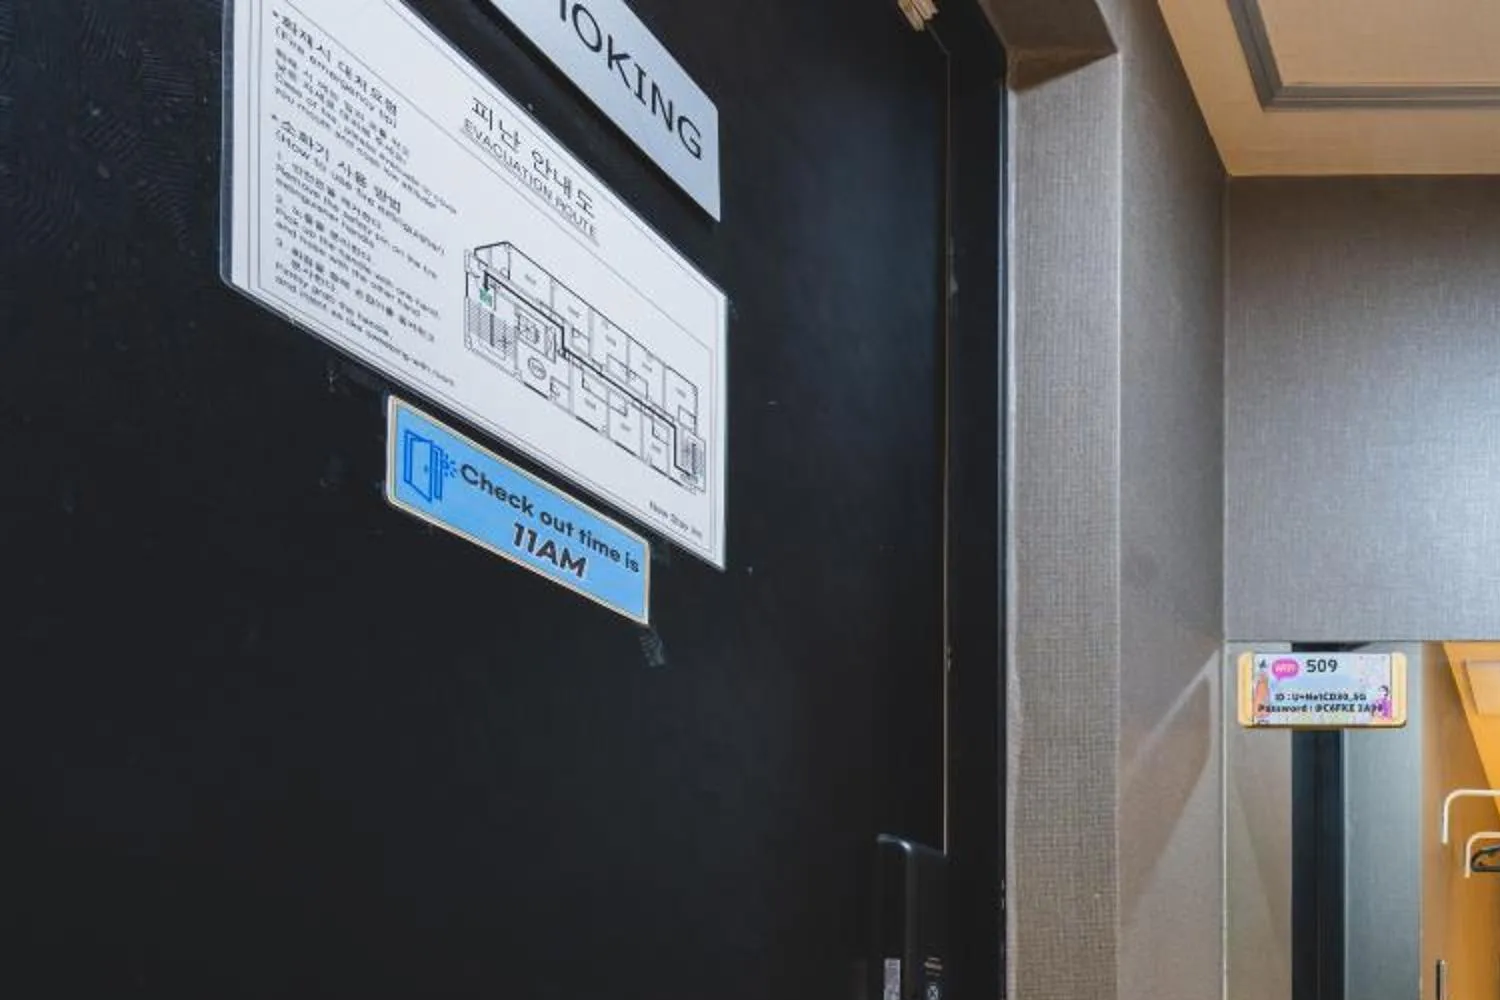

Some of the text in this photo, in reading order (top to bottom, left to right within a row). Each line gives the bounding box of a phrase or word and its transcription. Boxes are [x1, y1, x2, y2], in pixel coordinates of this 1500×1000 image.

[560, 0, 702, 160] OKING
[337, 156, 366, 189] 사용
[465, 117, 552, 201] EVACUATION
[555, 195, 596, 239] ROUTE
[472, 94, 520, 156] 피난
[532, 146, 594, 219] 안내도
[460, 462, 640, 574] Check out time is
[511, 521, 588, 579] 11AM
[1257, 703, 1307, 713] Password
[1305, 659, 1338, 673] 509
